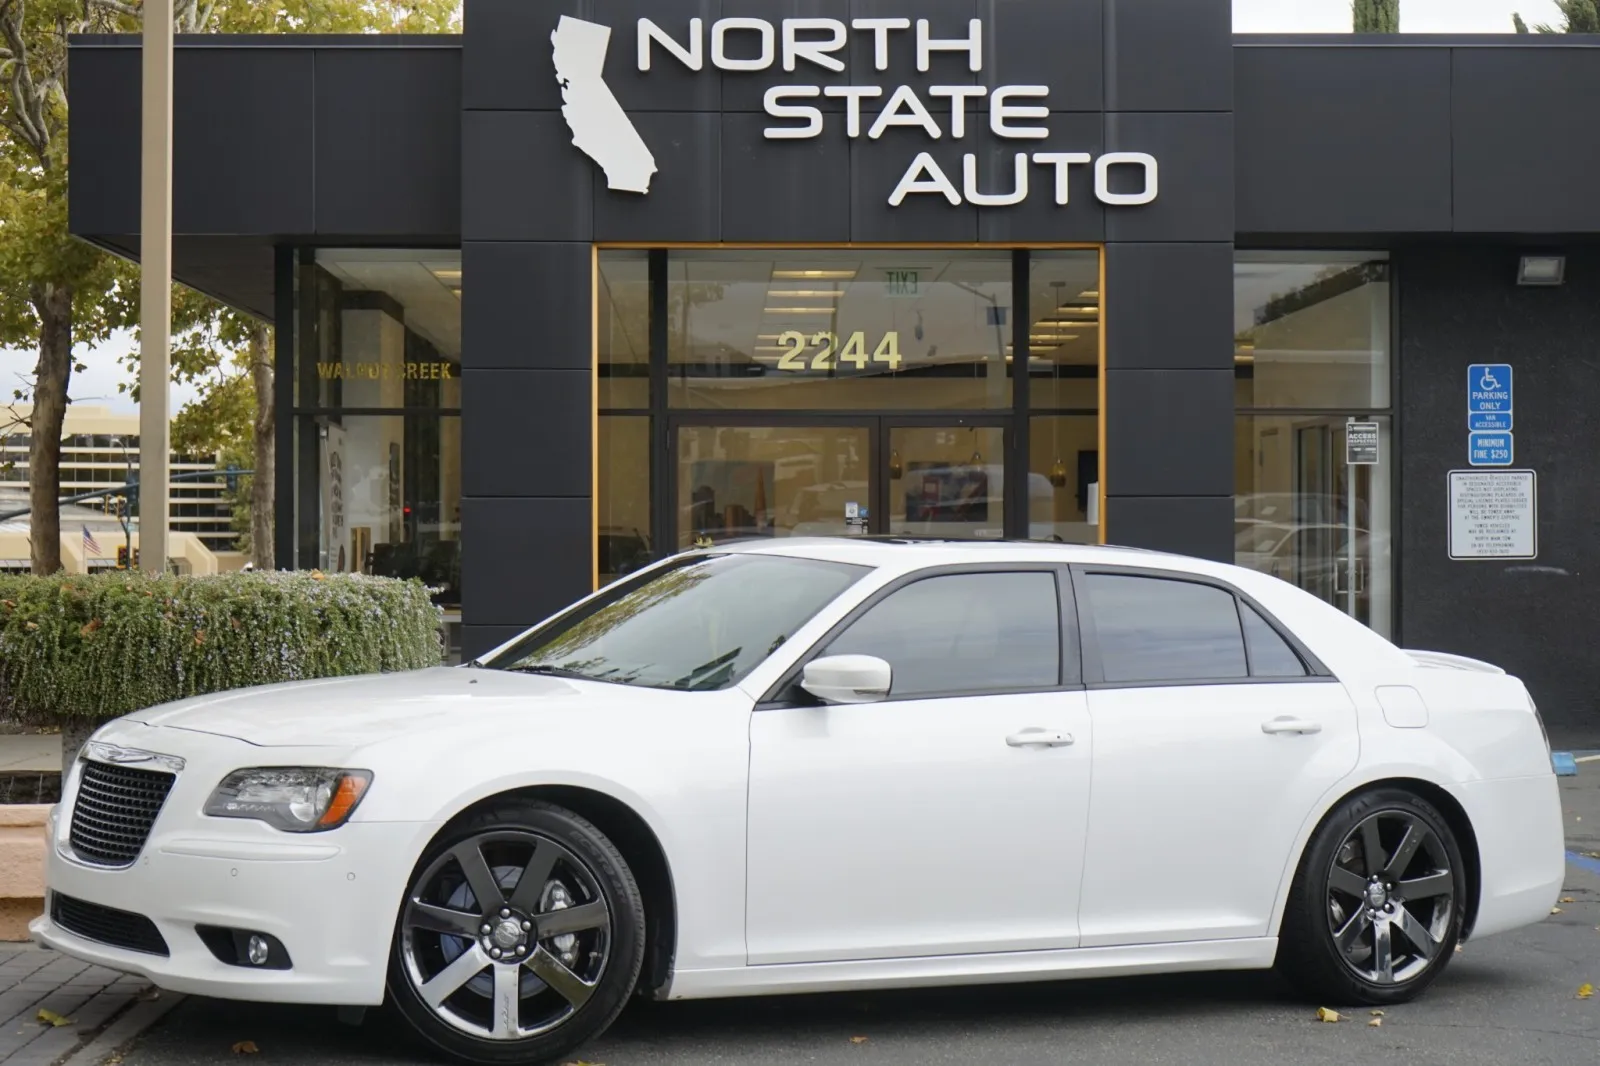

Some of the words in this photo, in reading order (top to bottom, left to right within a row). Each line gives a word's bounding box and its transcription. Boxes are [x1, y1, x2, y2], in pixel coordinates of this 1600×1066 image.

[637, 18, 982, 71] NORTH
[763, 85, 1050, 139] STATE
[888, 152, 1159, 207] AUTO
[777, 330, 902, 370] 2244
[397, 362, 452, 380] CREEK
[1472, 391, 1508, 400] PARKING
[1479, 402, 1501, 410] ONLY
[1477, 438, 1505, 447] MINIMUM
[1473, 450, 1488, 458] FINE
[1491, 449, 1508, 459] $250
